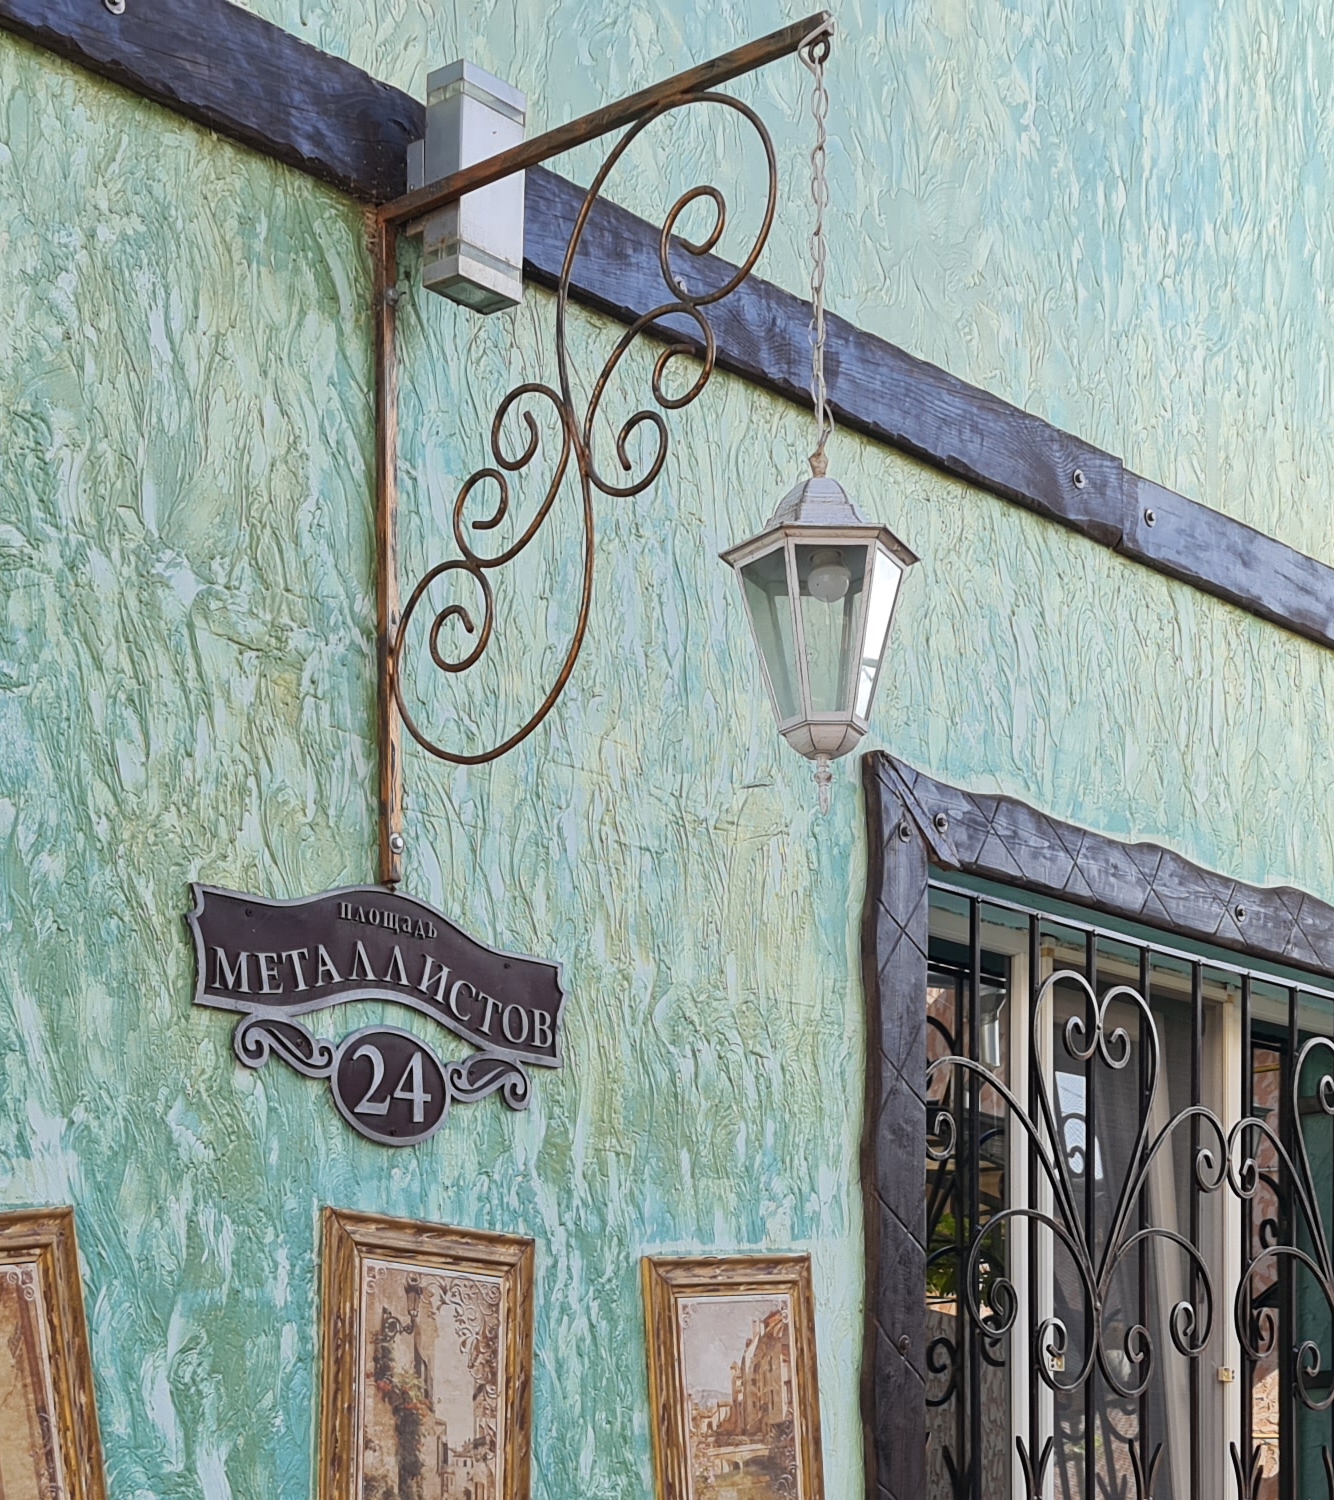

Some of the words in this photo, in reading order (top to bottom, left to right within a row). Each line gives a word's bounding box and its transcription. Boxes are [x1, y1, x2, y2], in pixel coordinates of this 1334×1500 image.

[339, 901, 438, 939] площадь
[210, 940, 553, 1049] МЕТАЛЛИСТОВ
[352, 1044, 431, 1123] 24
